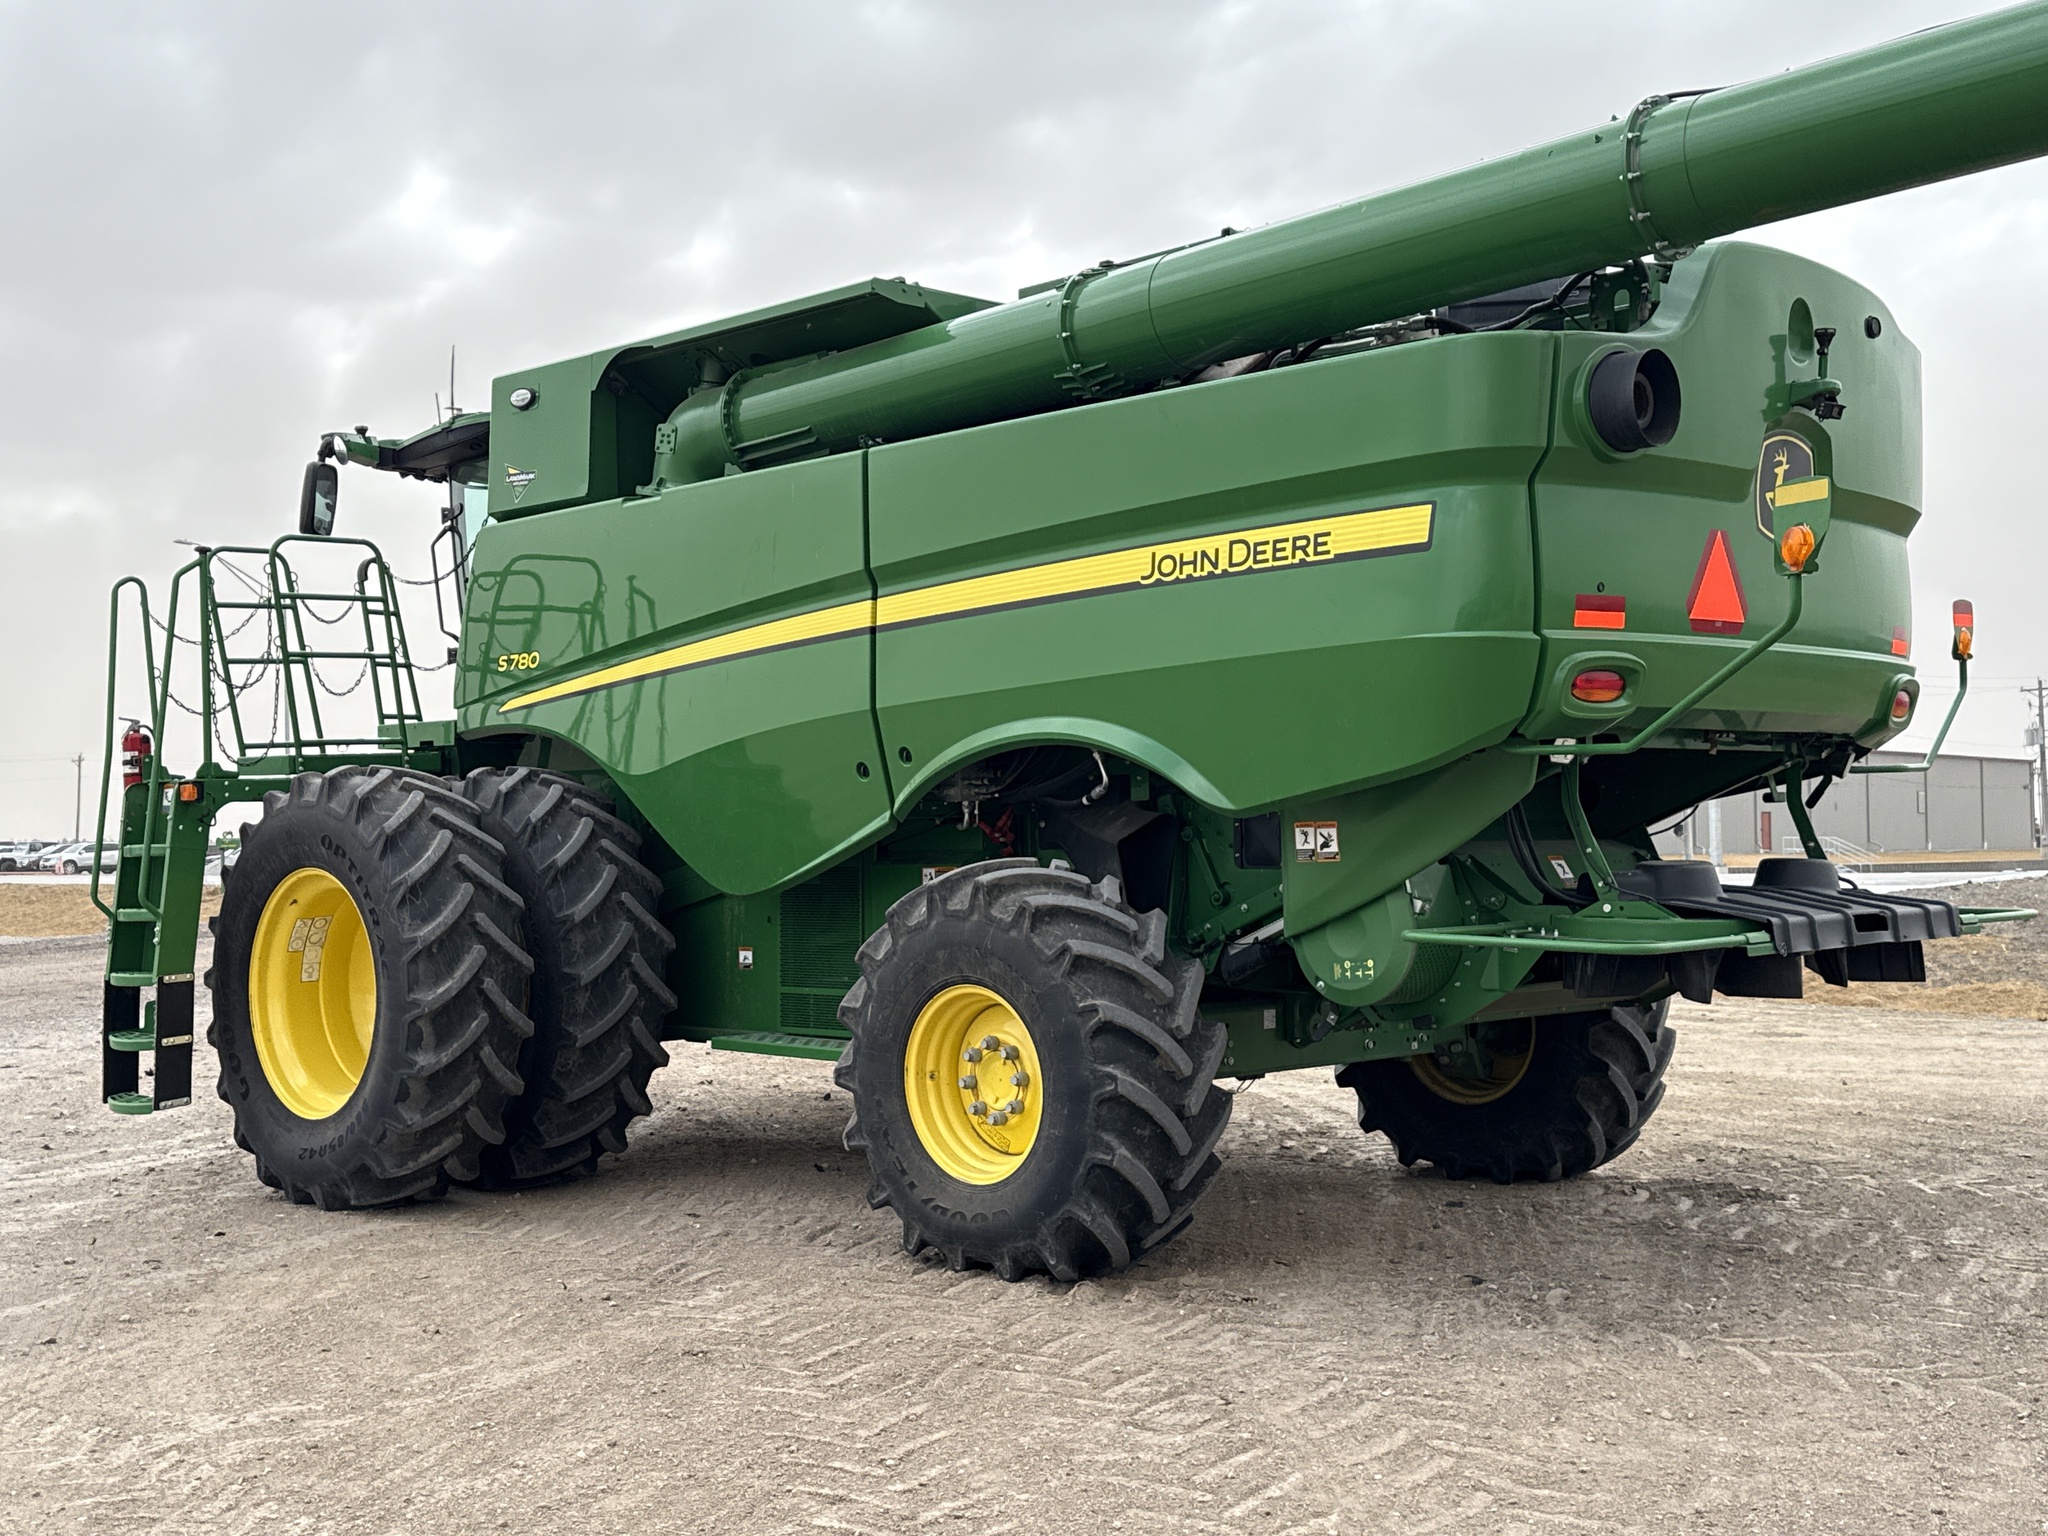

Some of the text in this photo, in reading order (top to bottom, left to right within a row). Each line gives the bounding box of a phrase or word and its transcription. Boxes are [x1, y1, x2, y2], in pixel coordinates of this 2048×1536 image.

[1140, 531, 1332, 581] JOHN DEERE
[497, 651, 540, 672] S780
[319, 832, 391, 981] OPTITRAC
